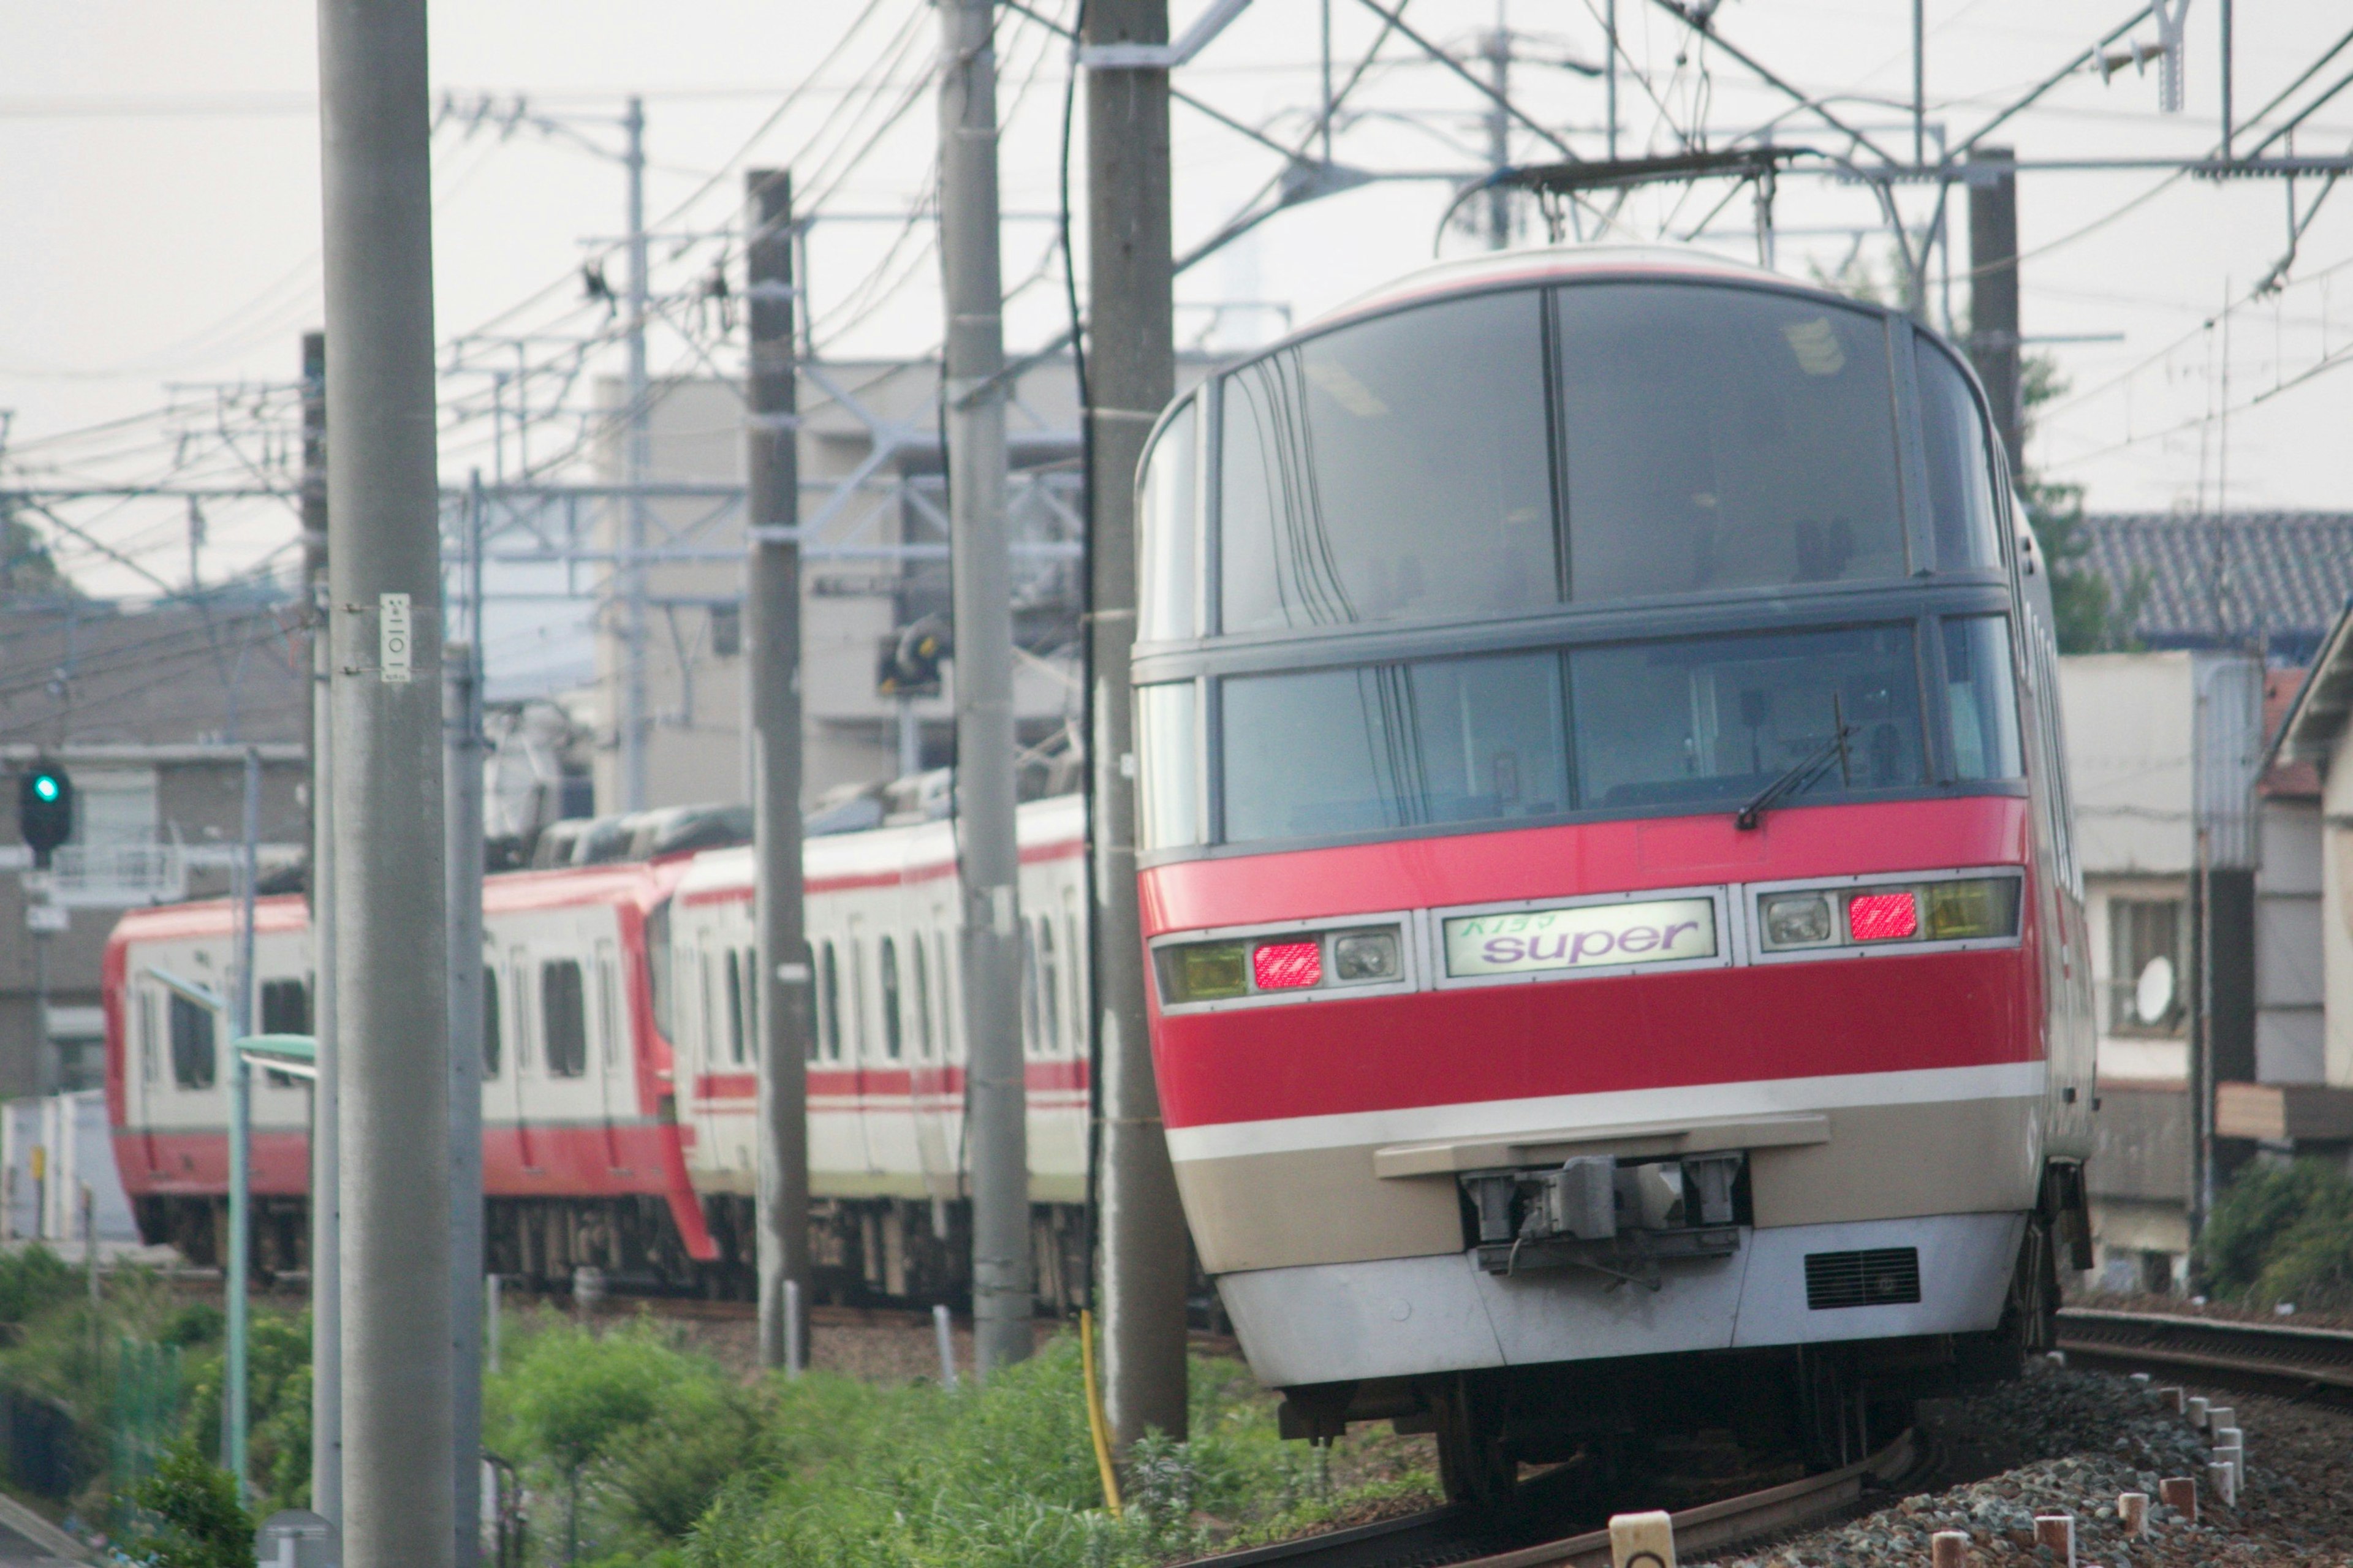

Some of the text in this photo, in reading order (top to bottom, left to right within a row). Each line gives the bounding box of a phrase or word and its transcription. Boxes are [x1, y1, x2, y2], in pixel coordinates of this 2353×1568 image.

[1460, 914, 1556, 937] パノラマ
[1481, 920, 1699, 964] super
